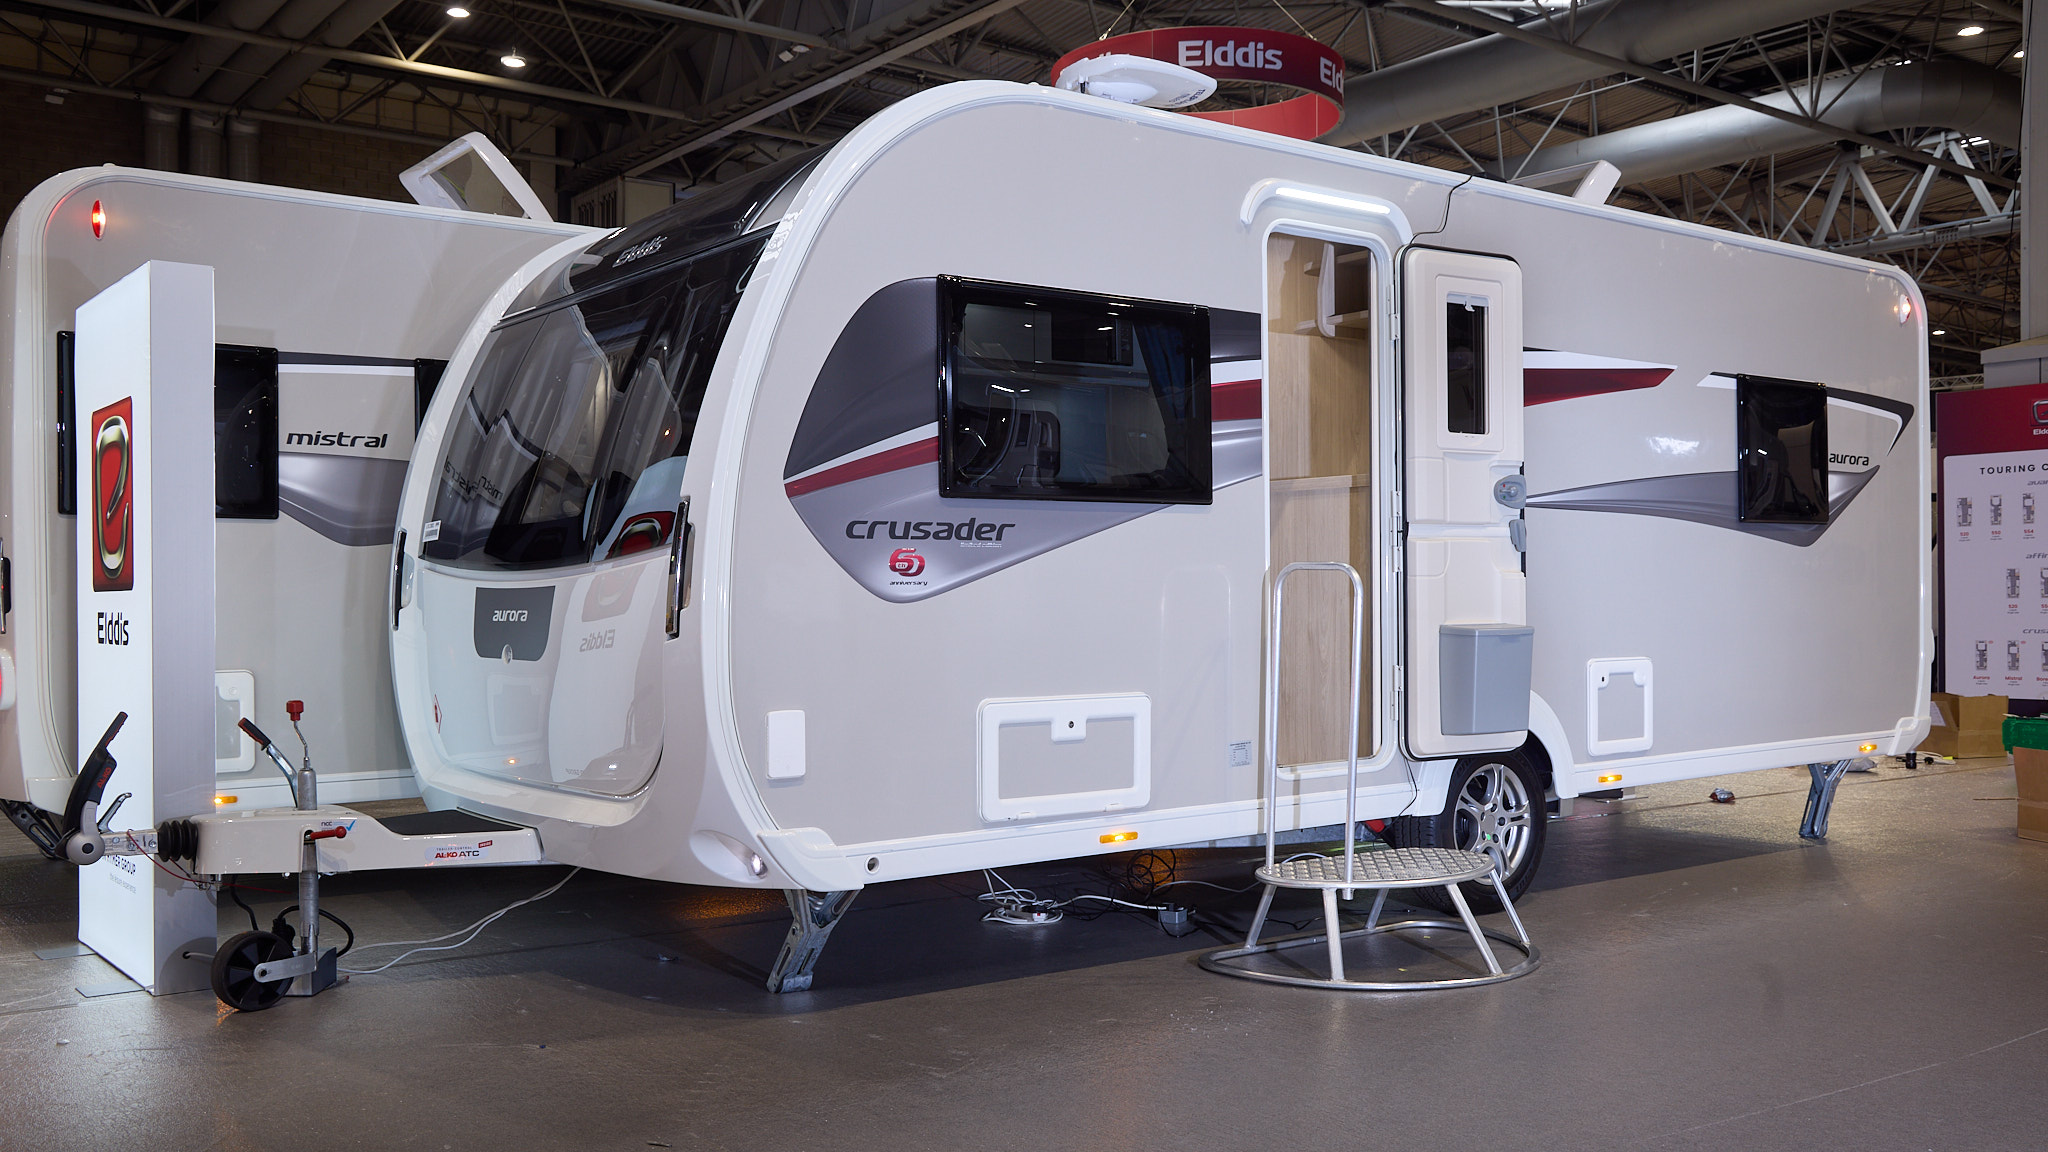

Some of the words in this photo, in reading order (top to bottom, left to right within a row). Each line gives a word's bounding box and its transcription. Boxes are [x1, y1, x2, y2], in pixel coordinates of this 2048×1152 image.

[1178, 40, 1283, 70] Elddis
[286, 430, 388, 448] mistral
[1829, 453, 1869, 466] aurora
[1979, 464, 2035, 475] TOURING
[846, 517, 1016, 541] crusader
[492, 609, 529, 622] aurora
[97, 612, 129, 646] Elddis
[459, 850, 480, 858] ATC
